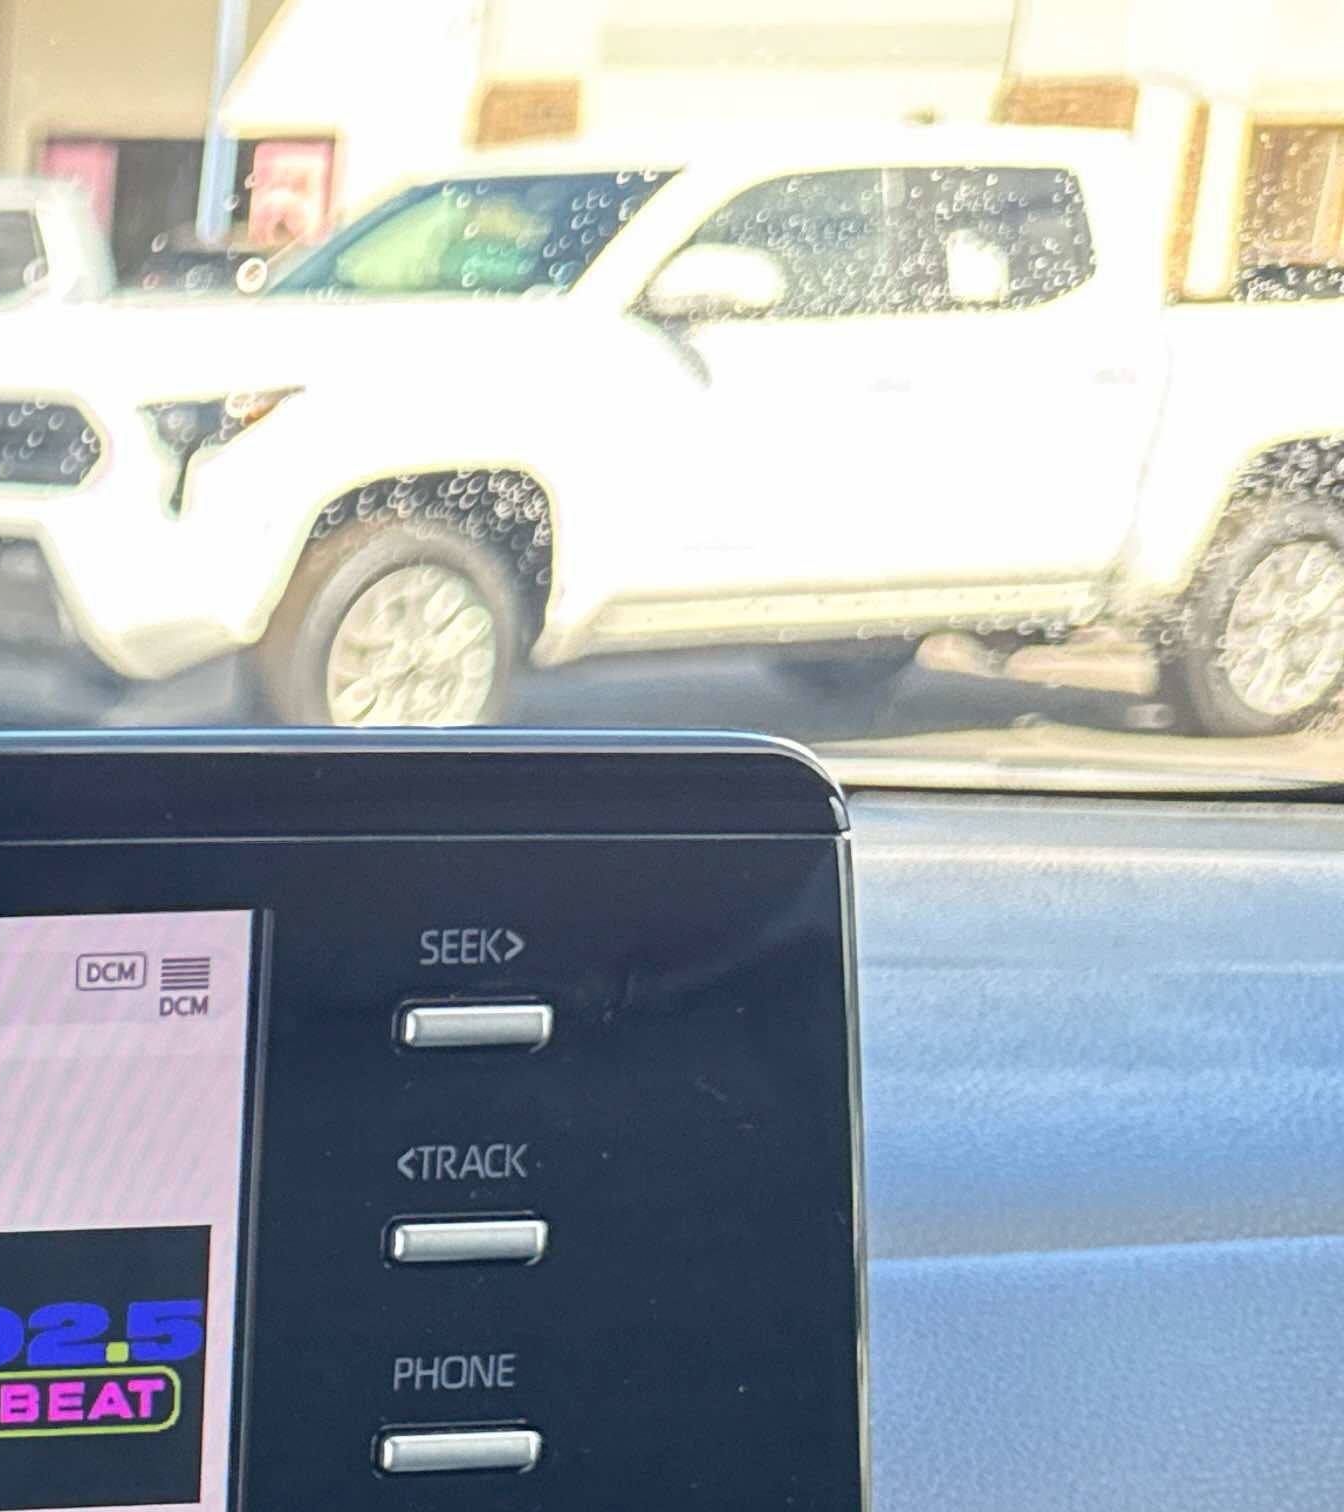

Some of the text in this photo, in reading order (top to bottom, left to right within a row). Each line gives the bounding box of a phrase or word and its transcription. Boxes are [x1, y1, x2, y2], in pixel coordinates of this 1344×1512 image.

[86, 961, 137, 983] DCM
[158, 996, 210, 1018] DCM
[392, 1353, 518, 1392] PHONE
[0, 1378, 166, 1424] BEAT
